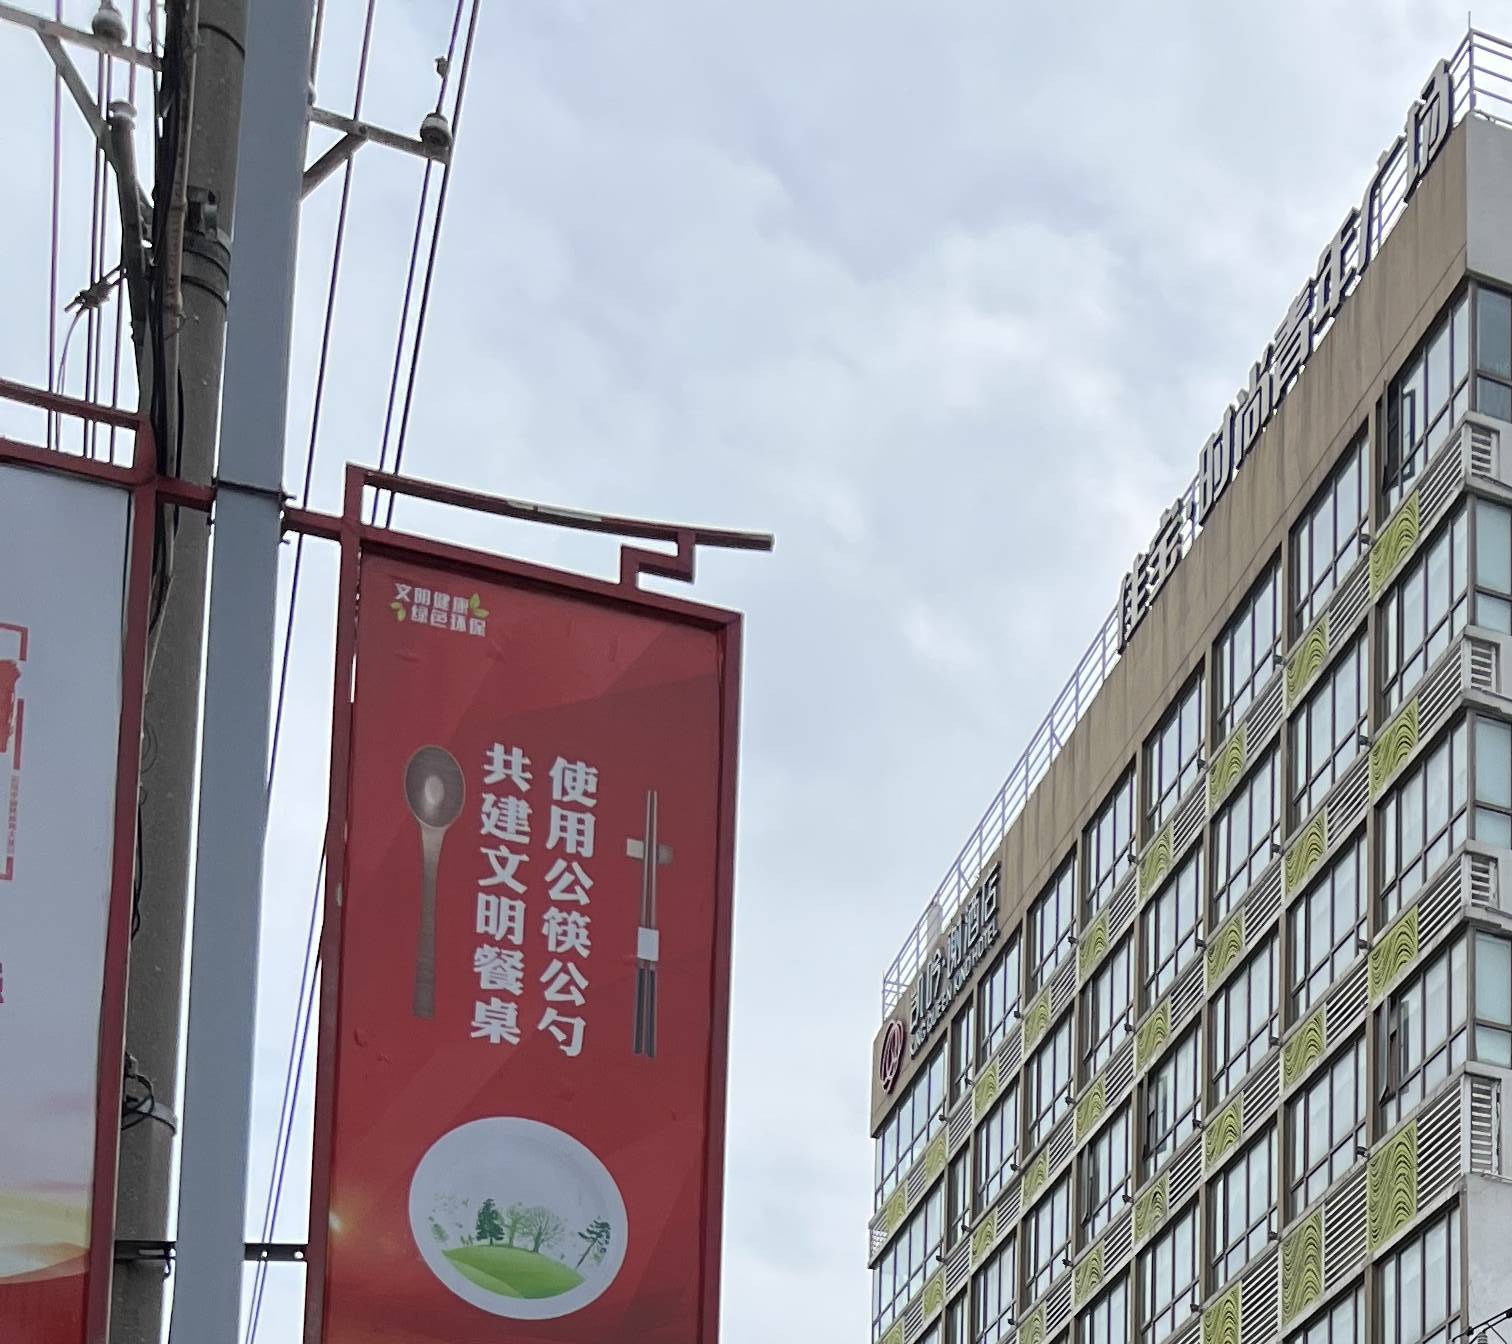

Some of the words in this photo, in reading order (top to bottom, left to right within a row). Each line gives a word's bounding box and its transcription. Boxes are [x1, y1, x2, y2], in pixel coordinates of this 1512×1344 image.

[394, 582, 470, 616] 文明健康
[411, 604, 486, 637] 绿色环保
[470, 742, 533, 1046] 共建文明餐桌
[537, 755, 599, 1057] 使用公筷公勺
